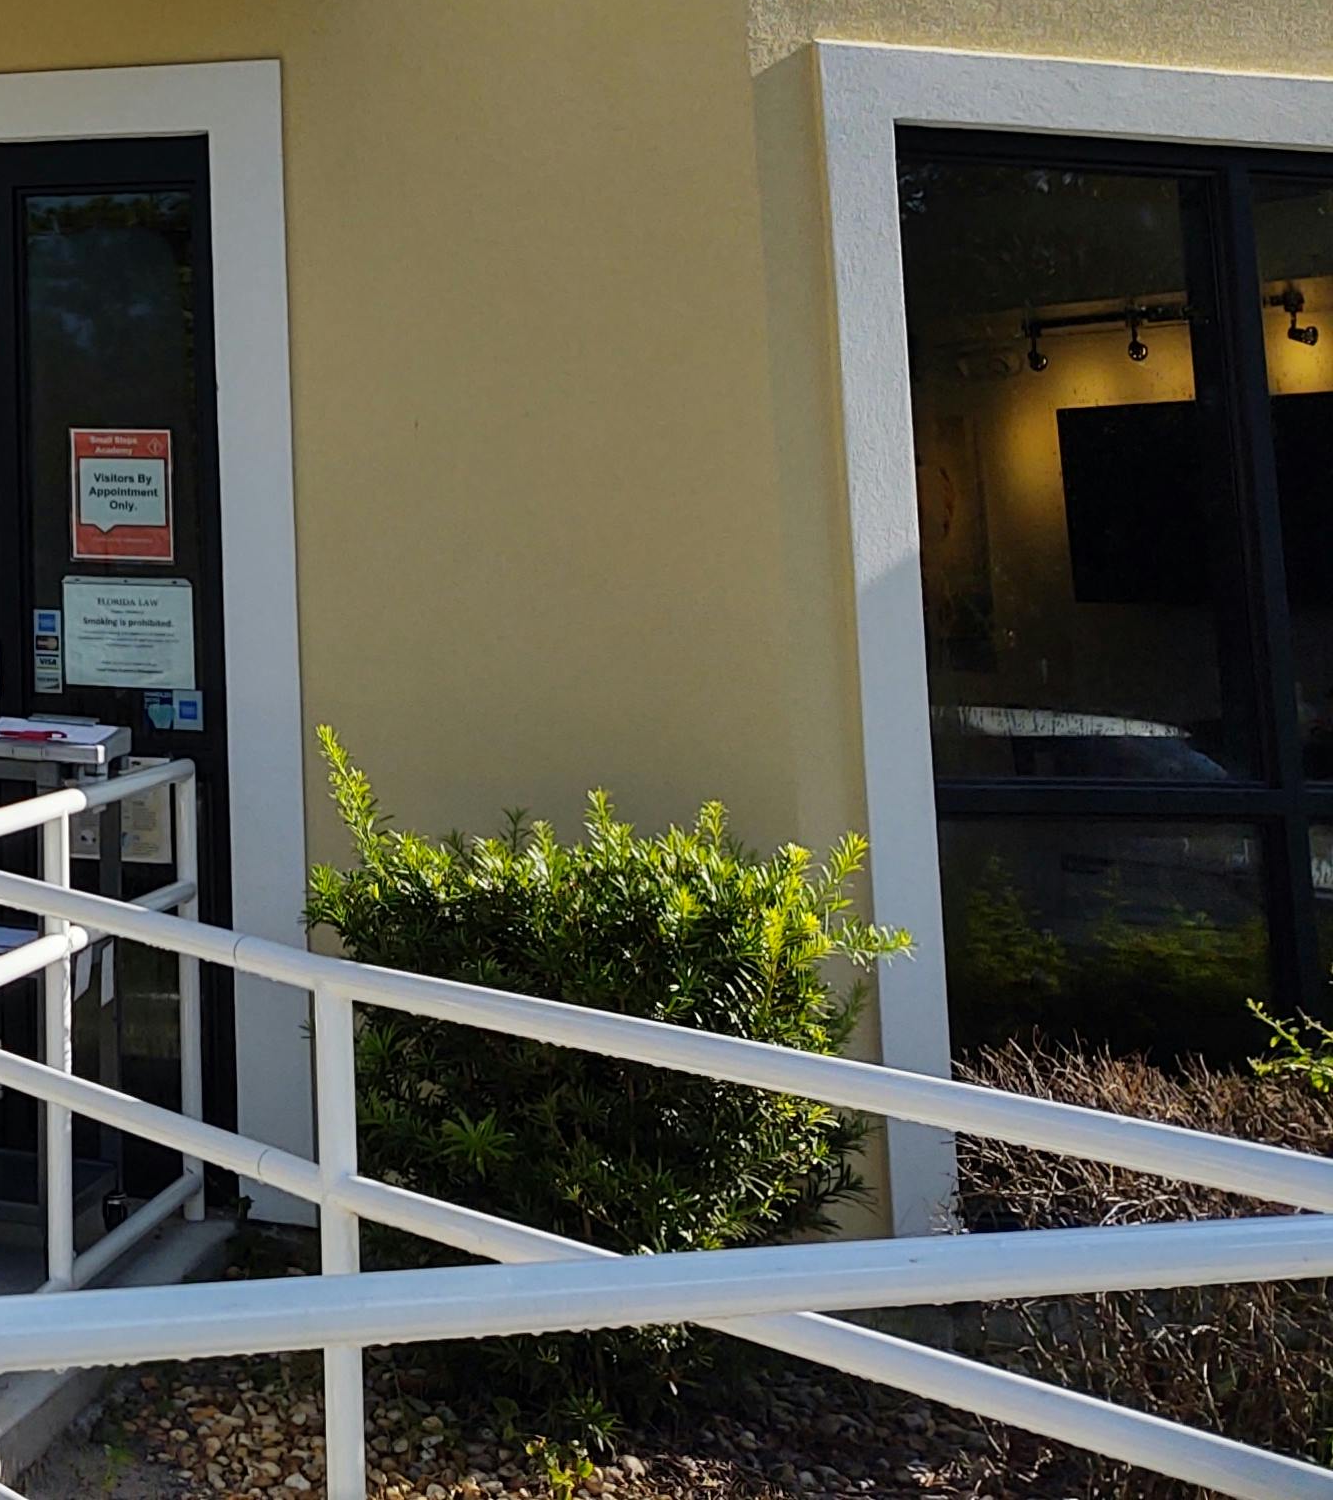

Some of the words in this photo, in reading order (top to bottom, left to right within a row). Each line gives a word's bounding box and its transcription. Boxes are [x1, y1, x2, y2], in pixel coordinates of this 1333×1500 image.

[93, 473, 135, 483] Visitors
[137, 473, 153, 485] By
[88, 486, 159, 498] Appointment
[109, 500, 138, 512] Only.
[97, 597, 136, 607] FLORIDA
[138, 597, 159, 607] LAW
[83, 616, 118, 627] Smoking
[119, 617, 127, 626] is
[39, 658, 57, 666] VISA
